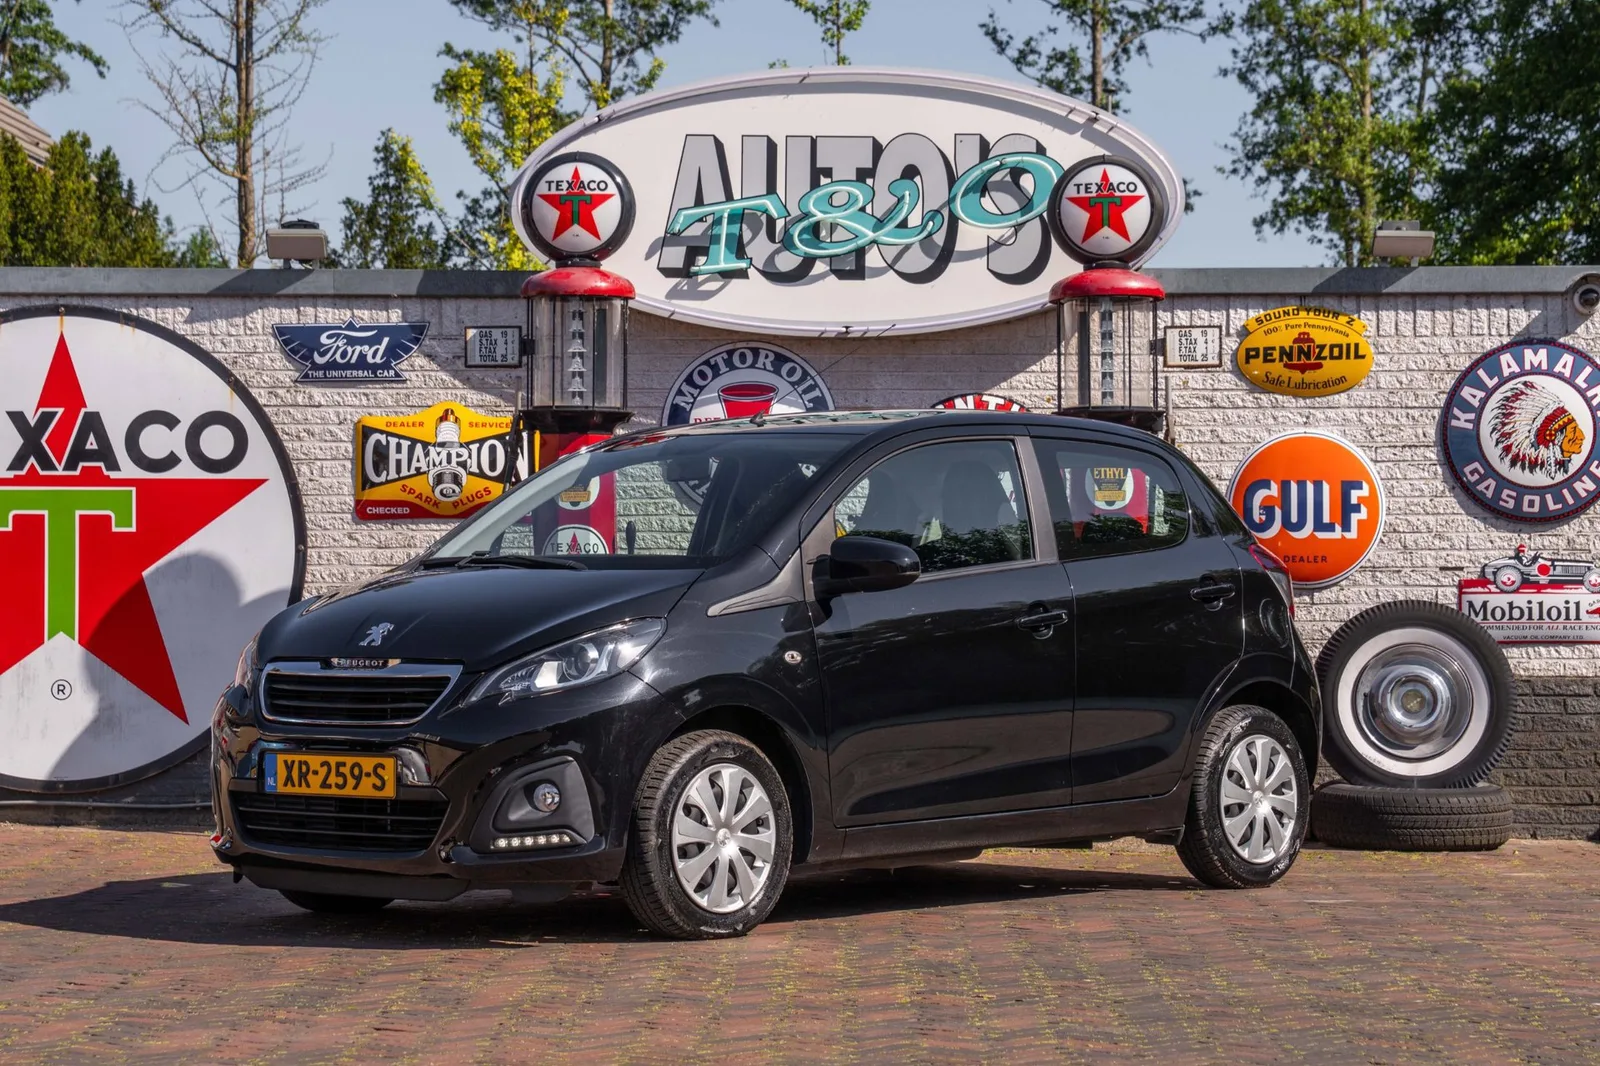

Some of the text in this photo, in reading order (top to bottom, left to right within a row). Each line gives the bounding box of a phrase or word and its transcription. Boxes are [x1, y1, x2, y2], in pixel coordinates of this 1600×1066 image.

[545, 179, 609, 192] TEXACO
[1073, 181, 1138, 195] TEXACO
[656, 132, 1052, 285] AUTO'S
[1255, 306, 1356, 327] SOUND YOUR Z
[479, 330, 508, 339] GAS 19
[1178, 329, 1208, 338] GAS 19
[1284, 322, 1303, 331] Pure
[1303, 321, 1350, 338] Pennsylvania
[313, 329, 390, 365] Ford
[478, 338, 508, 347] S.TAX 4
[1178, 337, 1208, 346] S.TAX 4
[478, 346, 497, 355] F.TAX
[1178, 346, 1197, 354] F.TAX
[1244, 342, 1367, 365] PENNZOIL
[478, 354, 509, 363] TOTAL 25
[1178, 353, 1209, 362] TOTAL 25
[307, 369, 396, 378] THE UNIVERSAL CAR
[672, 348, 824, 412] MOTOR OIL
[1262, 371, 1348, 390] Safe Lubrication
[385, 420, 512, 429] DEALER SERVICE
[1093, 467, 1127, 480] ETHYL
[399, 483, 492, 510] SPARK PLUGS
[366, 506, 410, 515] CHECKED
[1242, 478, 1370, 539] GULF
[550, 542, 599, 554] TEXACO
[1282, 554, 1328, 564] DEALER
[1466, 599, 1583, 622] Mobiloil
[341, 659, 385, 667] PEUGEOT
[282, 758, 387, 792] XR-259-S
[267, 777, 276, 786] NL
